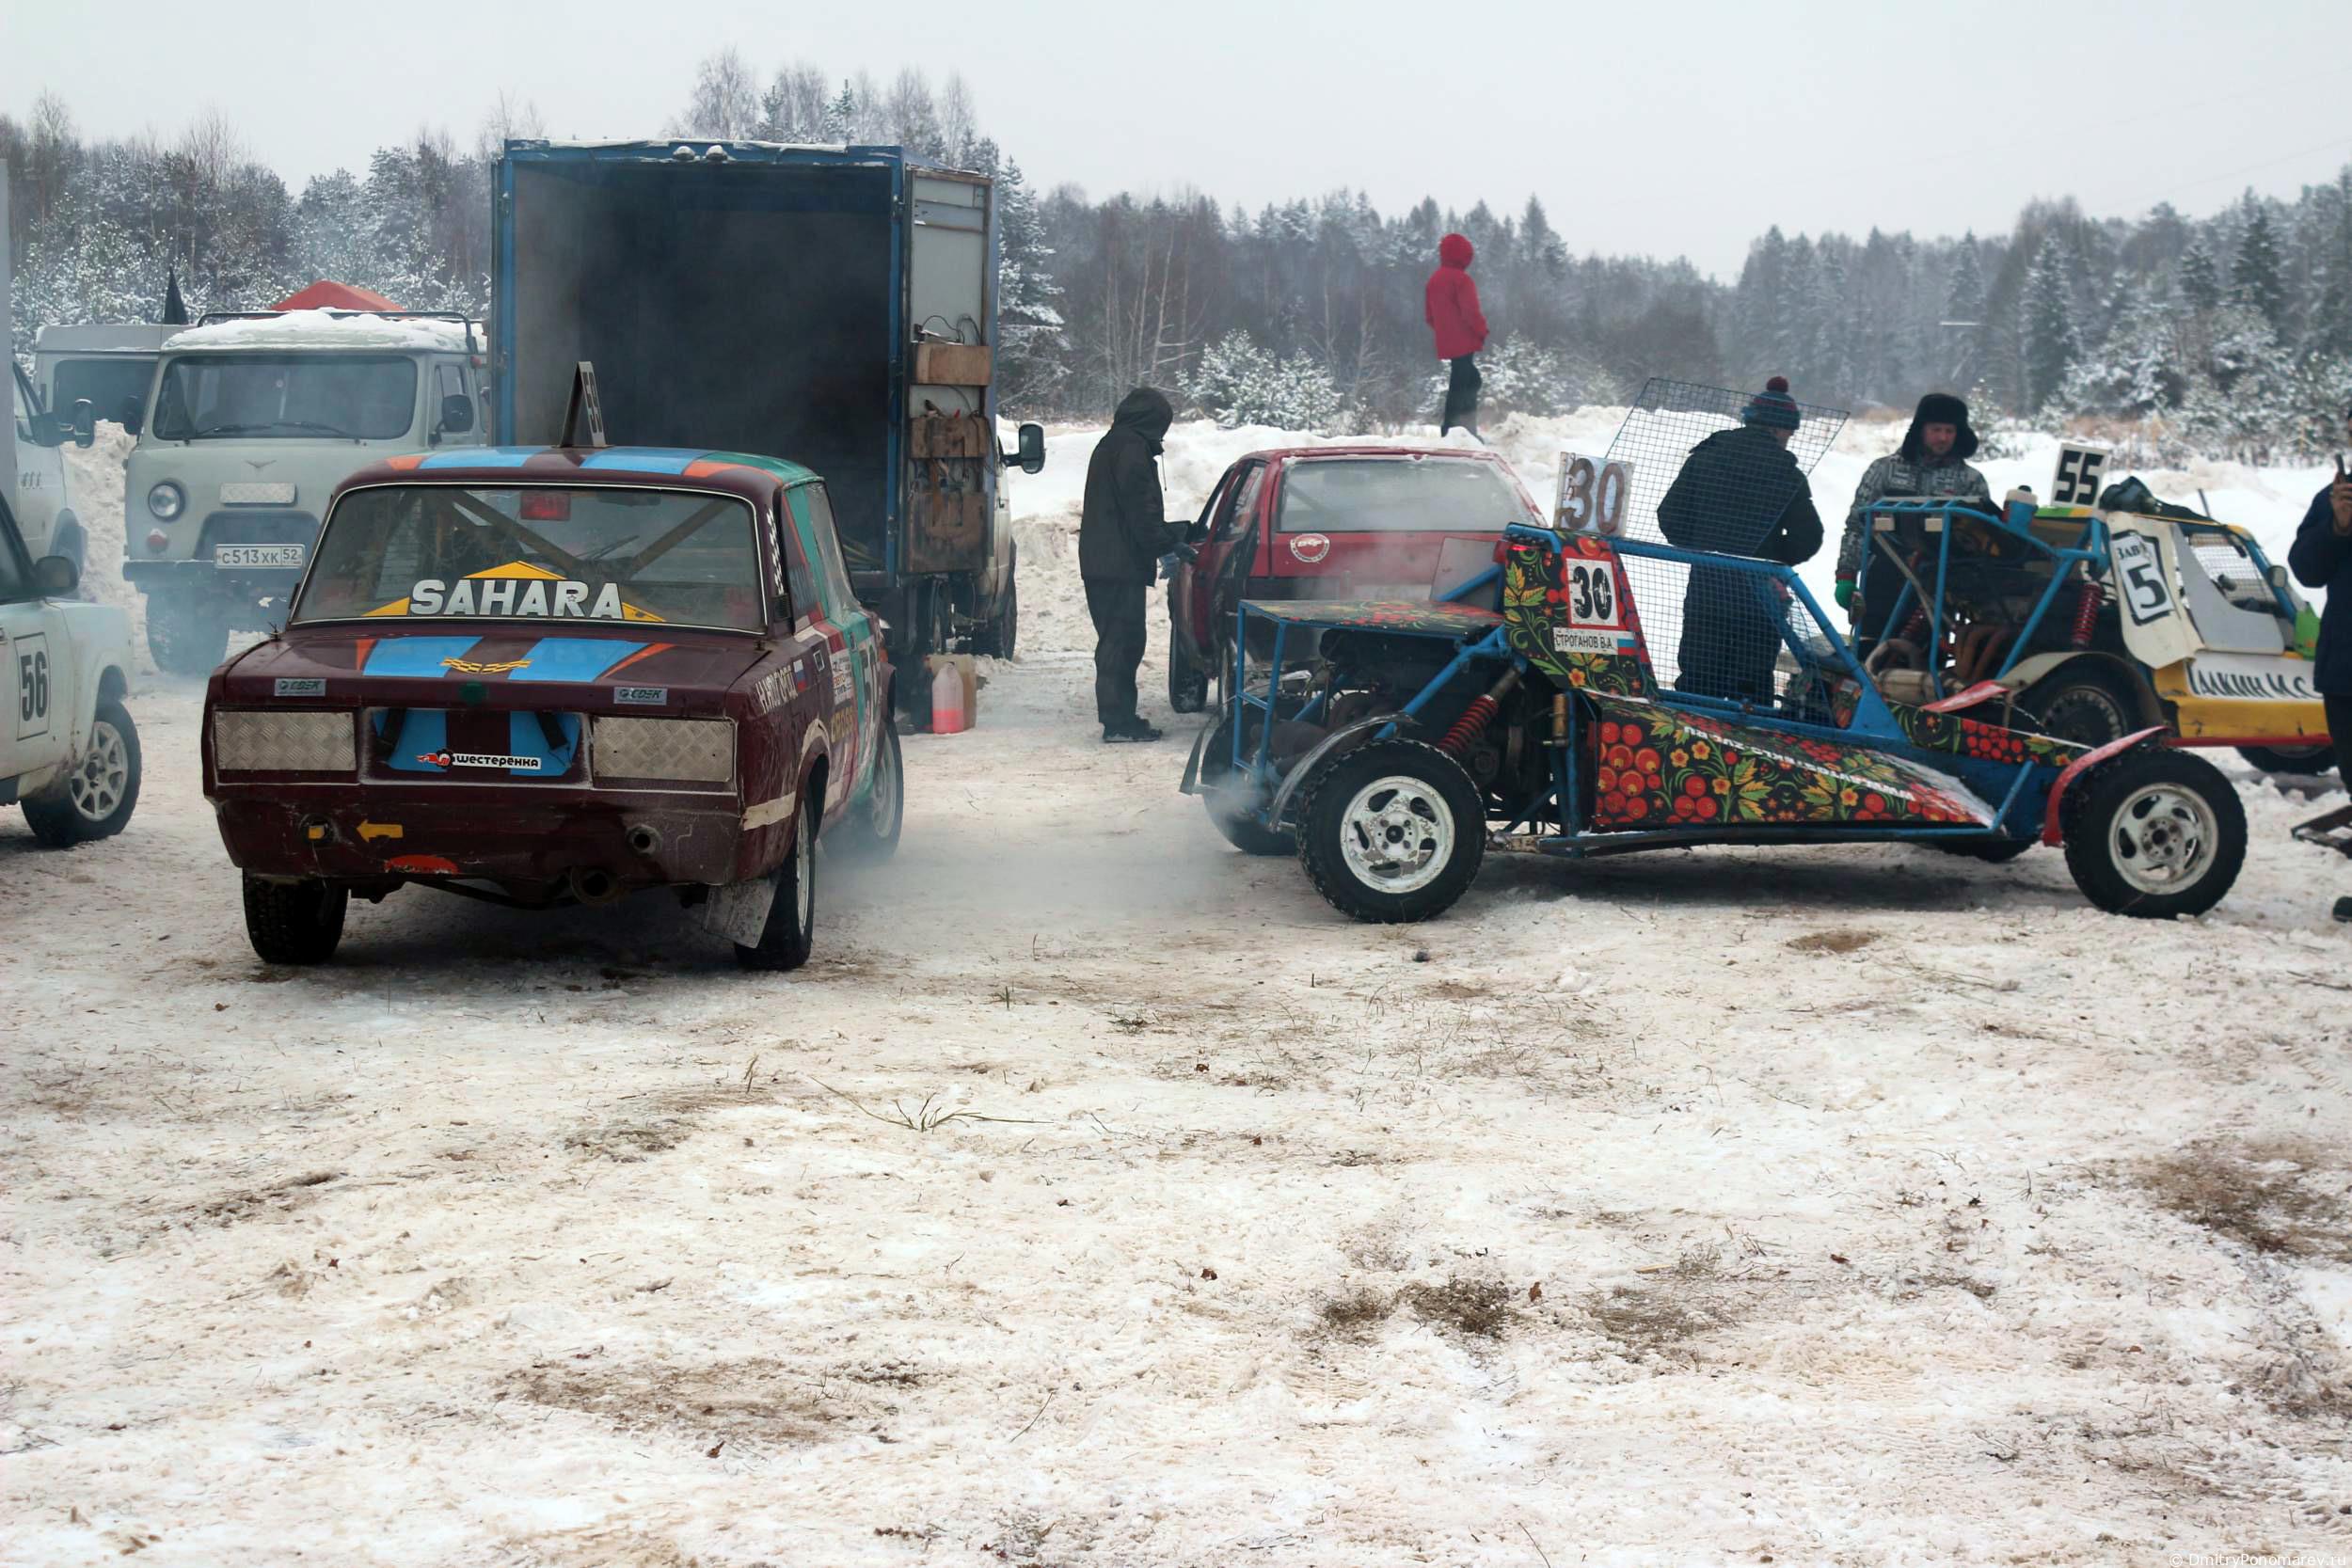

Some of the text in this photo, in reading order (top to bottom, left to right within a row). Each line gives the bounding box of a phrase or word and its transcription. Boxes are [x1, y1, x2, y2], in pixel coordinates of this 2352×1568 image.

[1556, 457, 1625, 535] 30
[2054, 449, 2106, 506] 55
[282, 548, 298, 561] 52
[409, 578, 624, 620] SAHARA
[1572, 565, 1613, 620] 30
[2127, 563, 2168, 610] 5
[1555, 634, 1598, 649] СТРОГАНОВ
[20, 651, 48, 721] 56
